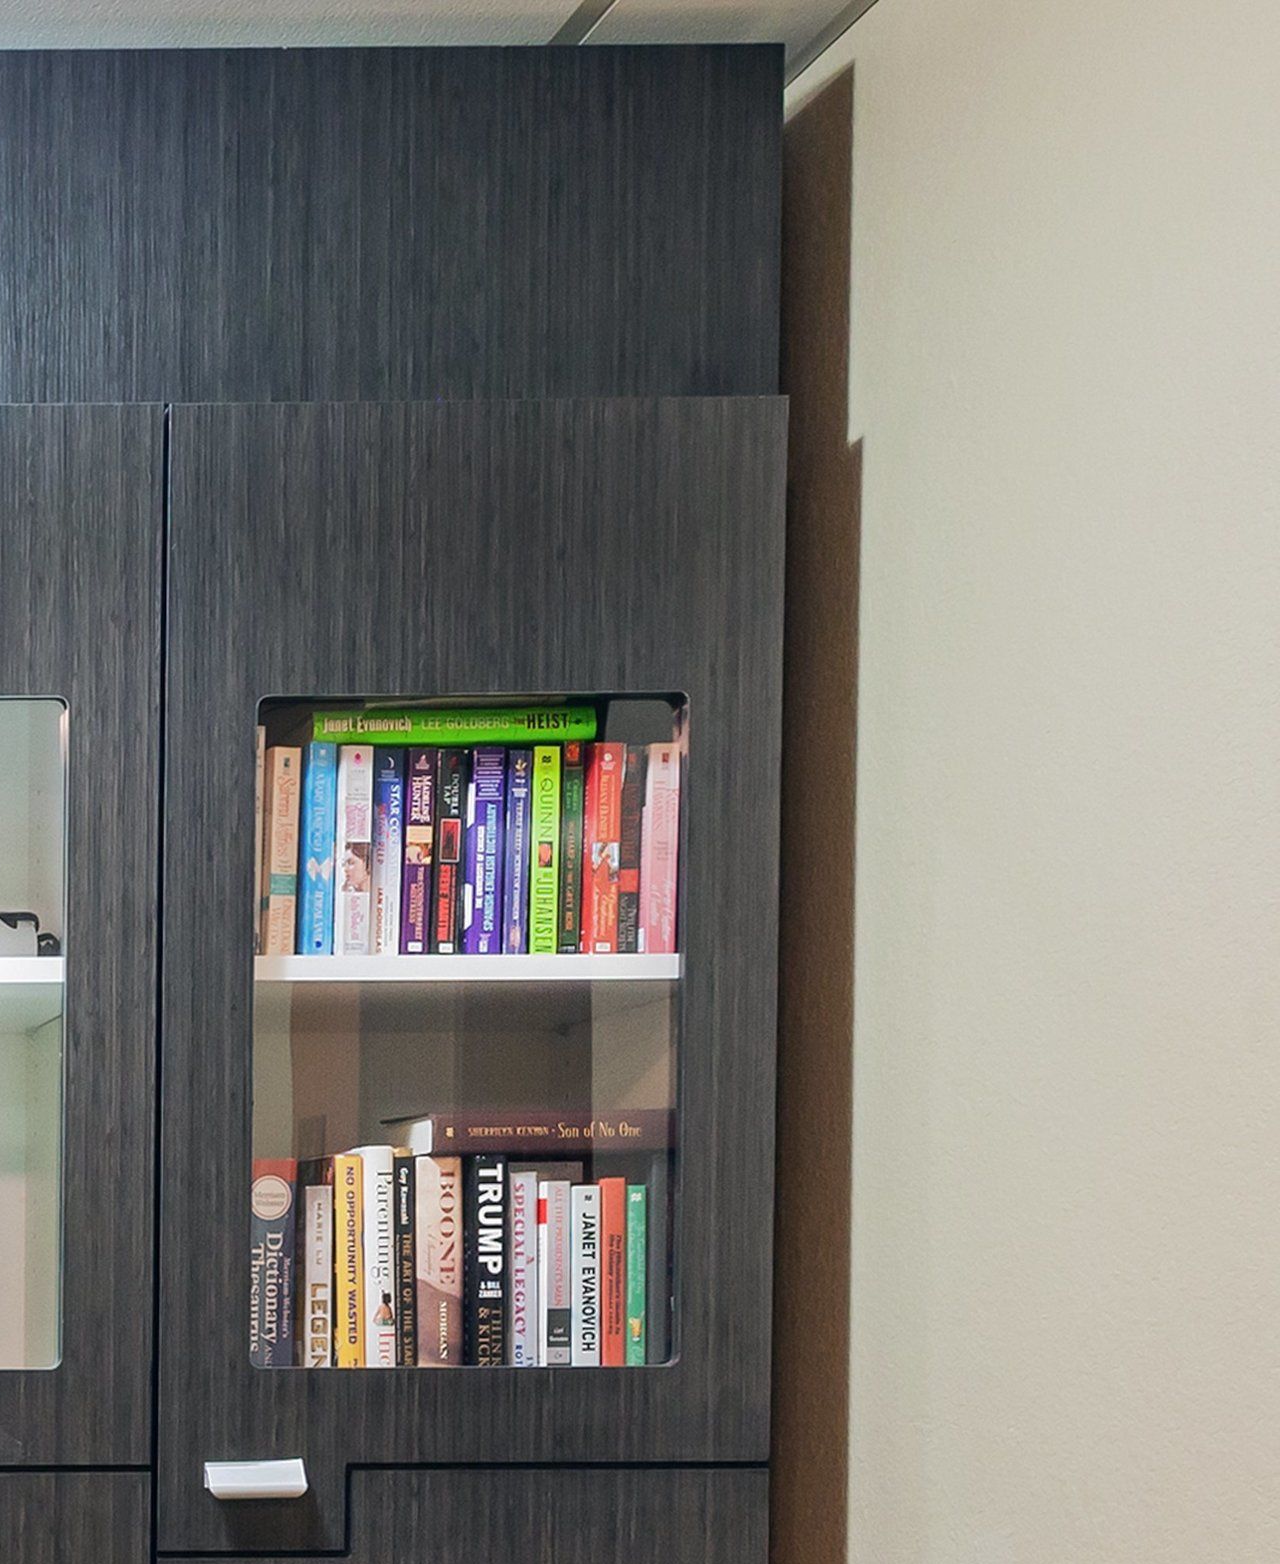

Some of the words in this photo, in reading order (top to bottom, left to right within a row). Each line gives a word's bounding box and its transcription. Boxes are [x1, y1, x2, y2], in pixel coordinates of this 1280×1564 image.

[323, 717, 353, 733] Janet
[357, 715, 412, 733] Evanovich
[421, 718, 441, 730] LEE
[446, 716, 510, 730] GOLDBERG
[527, 713, 569, 730] HEIST
[390, 784, 400, 815] STAR
[411, 776, 421, 821] HUNTER
[421, 775, 432, 824] MADELINE
[443, 785, 452, 804] TAP
[450, 773, 460, 815] DOUBLE
[539, 778, 554, 838] QUINN
[486, 803, 497, 854] DICTIONARY
[483, 855, 495, 931] SPANISH-ENGLISH
[535, 877, 554, 952] JOHANSEN
[375, 907, 383, 953] DOUGLAS
[557, 1122, 580, 1139] Son
[583, 1121, 596, 1137] of
[599, 1121, 616, 1137] No
[346, 1166, 355, 1186] NO
[399, 1168, 408, 1184] Guy
[400, 1186, 409, 1225] Kawasaki
[439, 1170, 456, 1285] BOONE
[477, 1163, 503, 1275] TRUMP
[513, 1183, 526, 1260] SPECIAL
[346, 1190, 358, 1285] OPPORTUNITY
[402, 1232, 413, 1256] THE
[582, 1212, 596, 1260] JANET
[261, 1231, 284, 1344] Dictionary
[402, 1261, 413, 1284] ART
[402, 1288, 413, 1303] OF
[251, 1242, 265, 1353] Thesaurus
[347, 1289, 358, 1345] WASTED
[403, 1309, 413, 1333] THE
[478, 1306, 490, 1319] &
[513, 1268, 526, 1338] LEGACY
[582, 1266, 596, 1352] EVANOVICH
[311, 1282, 328, 1368] LEGEN
[439, 1301, 449, 1361] MORGAN
[478, 1324, 490, 1367] KICK
[491, 1306, 502, 1367] THINK
